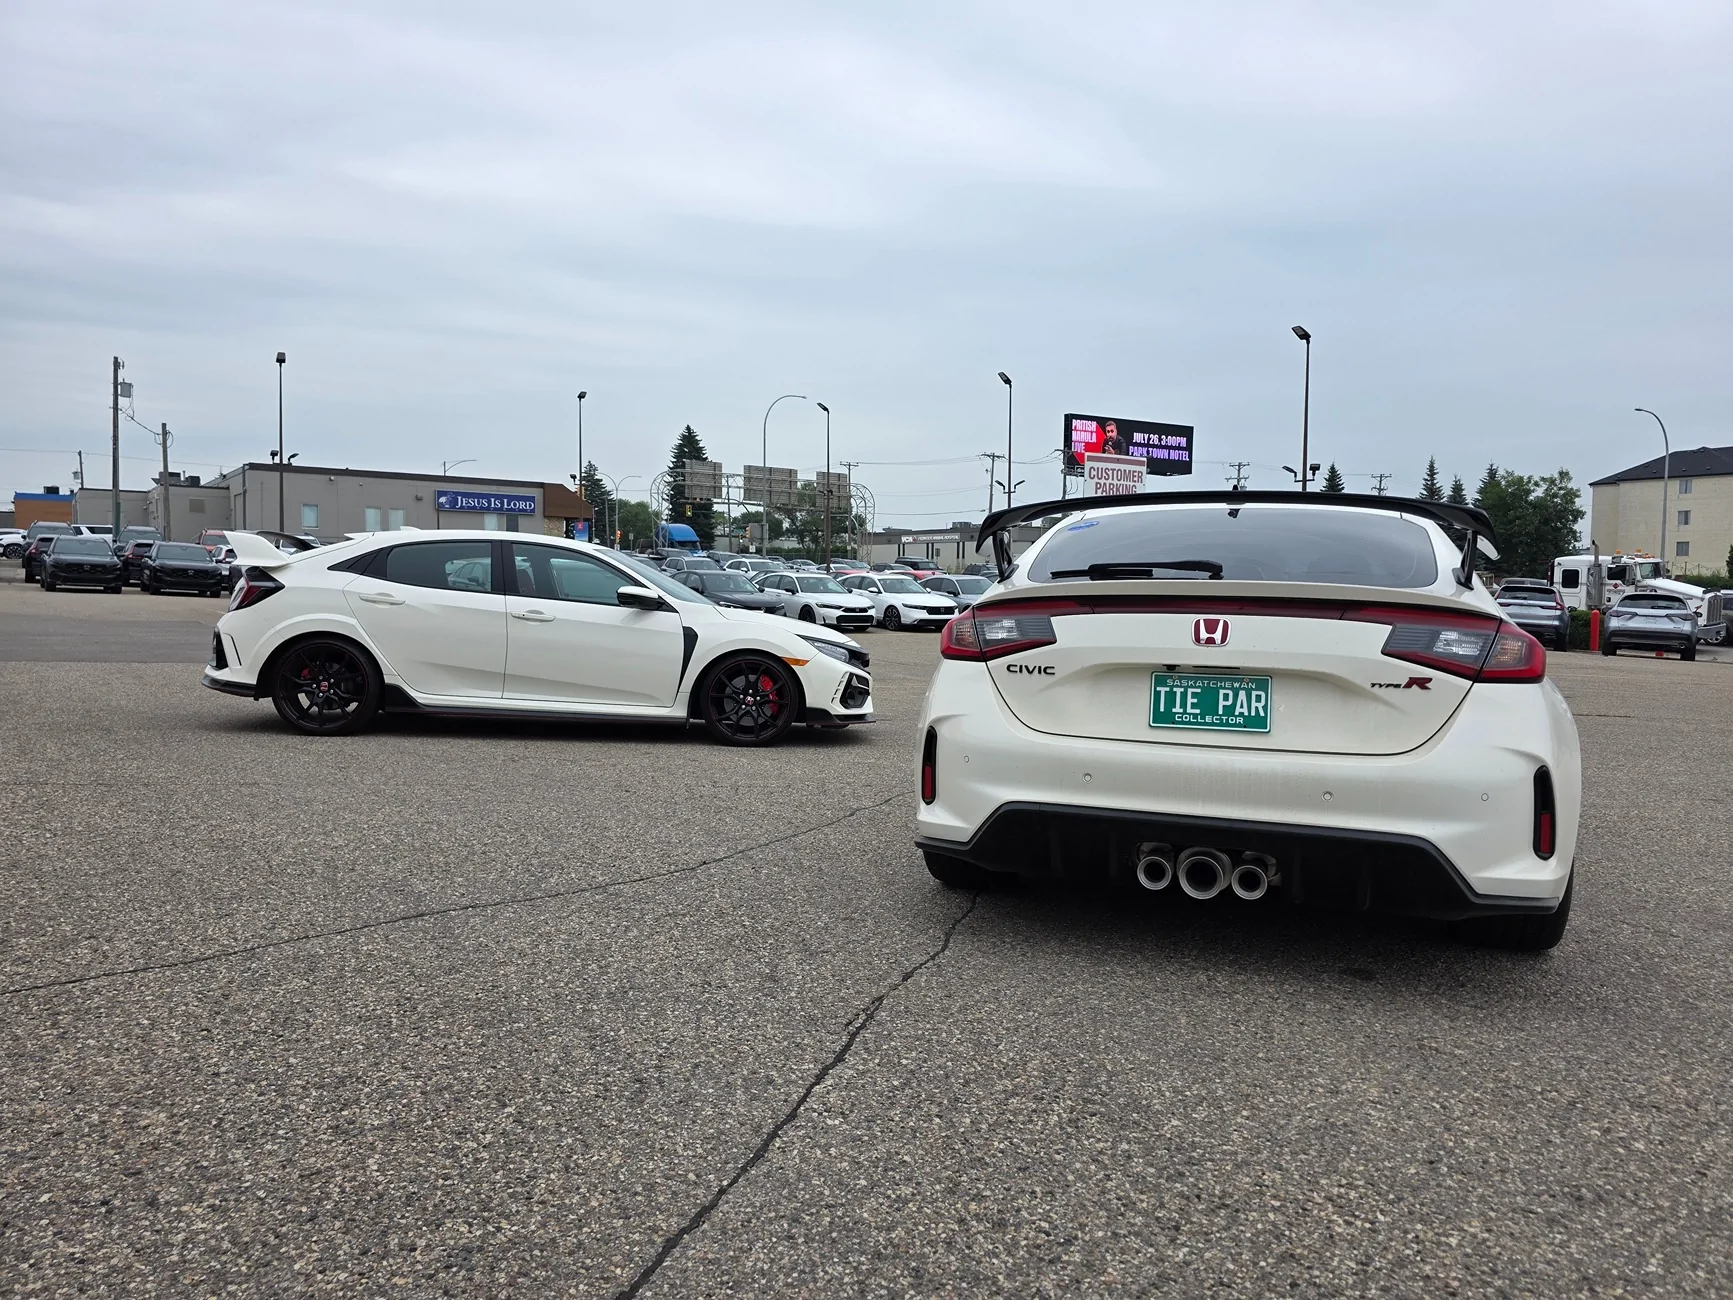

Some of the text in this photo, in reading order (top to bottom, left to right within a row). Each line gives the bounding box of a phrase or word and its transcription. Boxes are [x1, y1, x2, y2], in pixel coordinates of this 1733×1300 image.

[1072, 419, 1096, 432] PRITISH
[1132, 432, 1187, 448] JULY 26, 3:00PM
[1072, 442, 1085, 452] LIVE
[1128, 446, 1190, 461] PARK TOWN HOTEL
[1088, 466, 1144, 484] CUSTOMER
[1094, 482, 1137, 495] PARKING
[456, 496, 488, 508] JESUS
[504, 498, 534, 510] LORD
[1006, 664, 1056, 676] CIVIC
[1166, 679, 1256, 688] SASKATCHEWAN
[1402, 676, 1433, 690] R
[1156, 687, 1266, 716] TIE PAR
[1175, 714, 1244, 724] COLLECTOR
